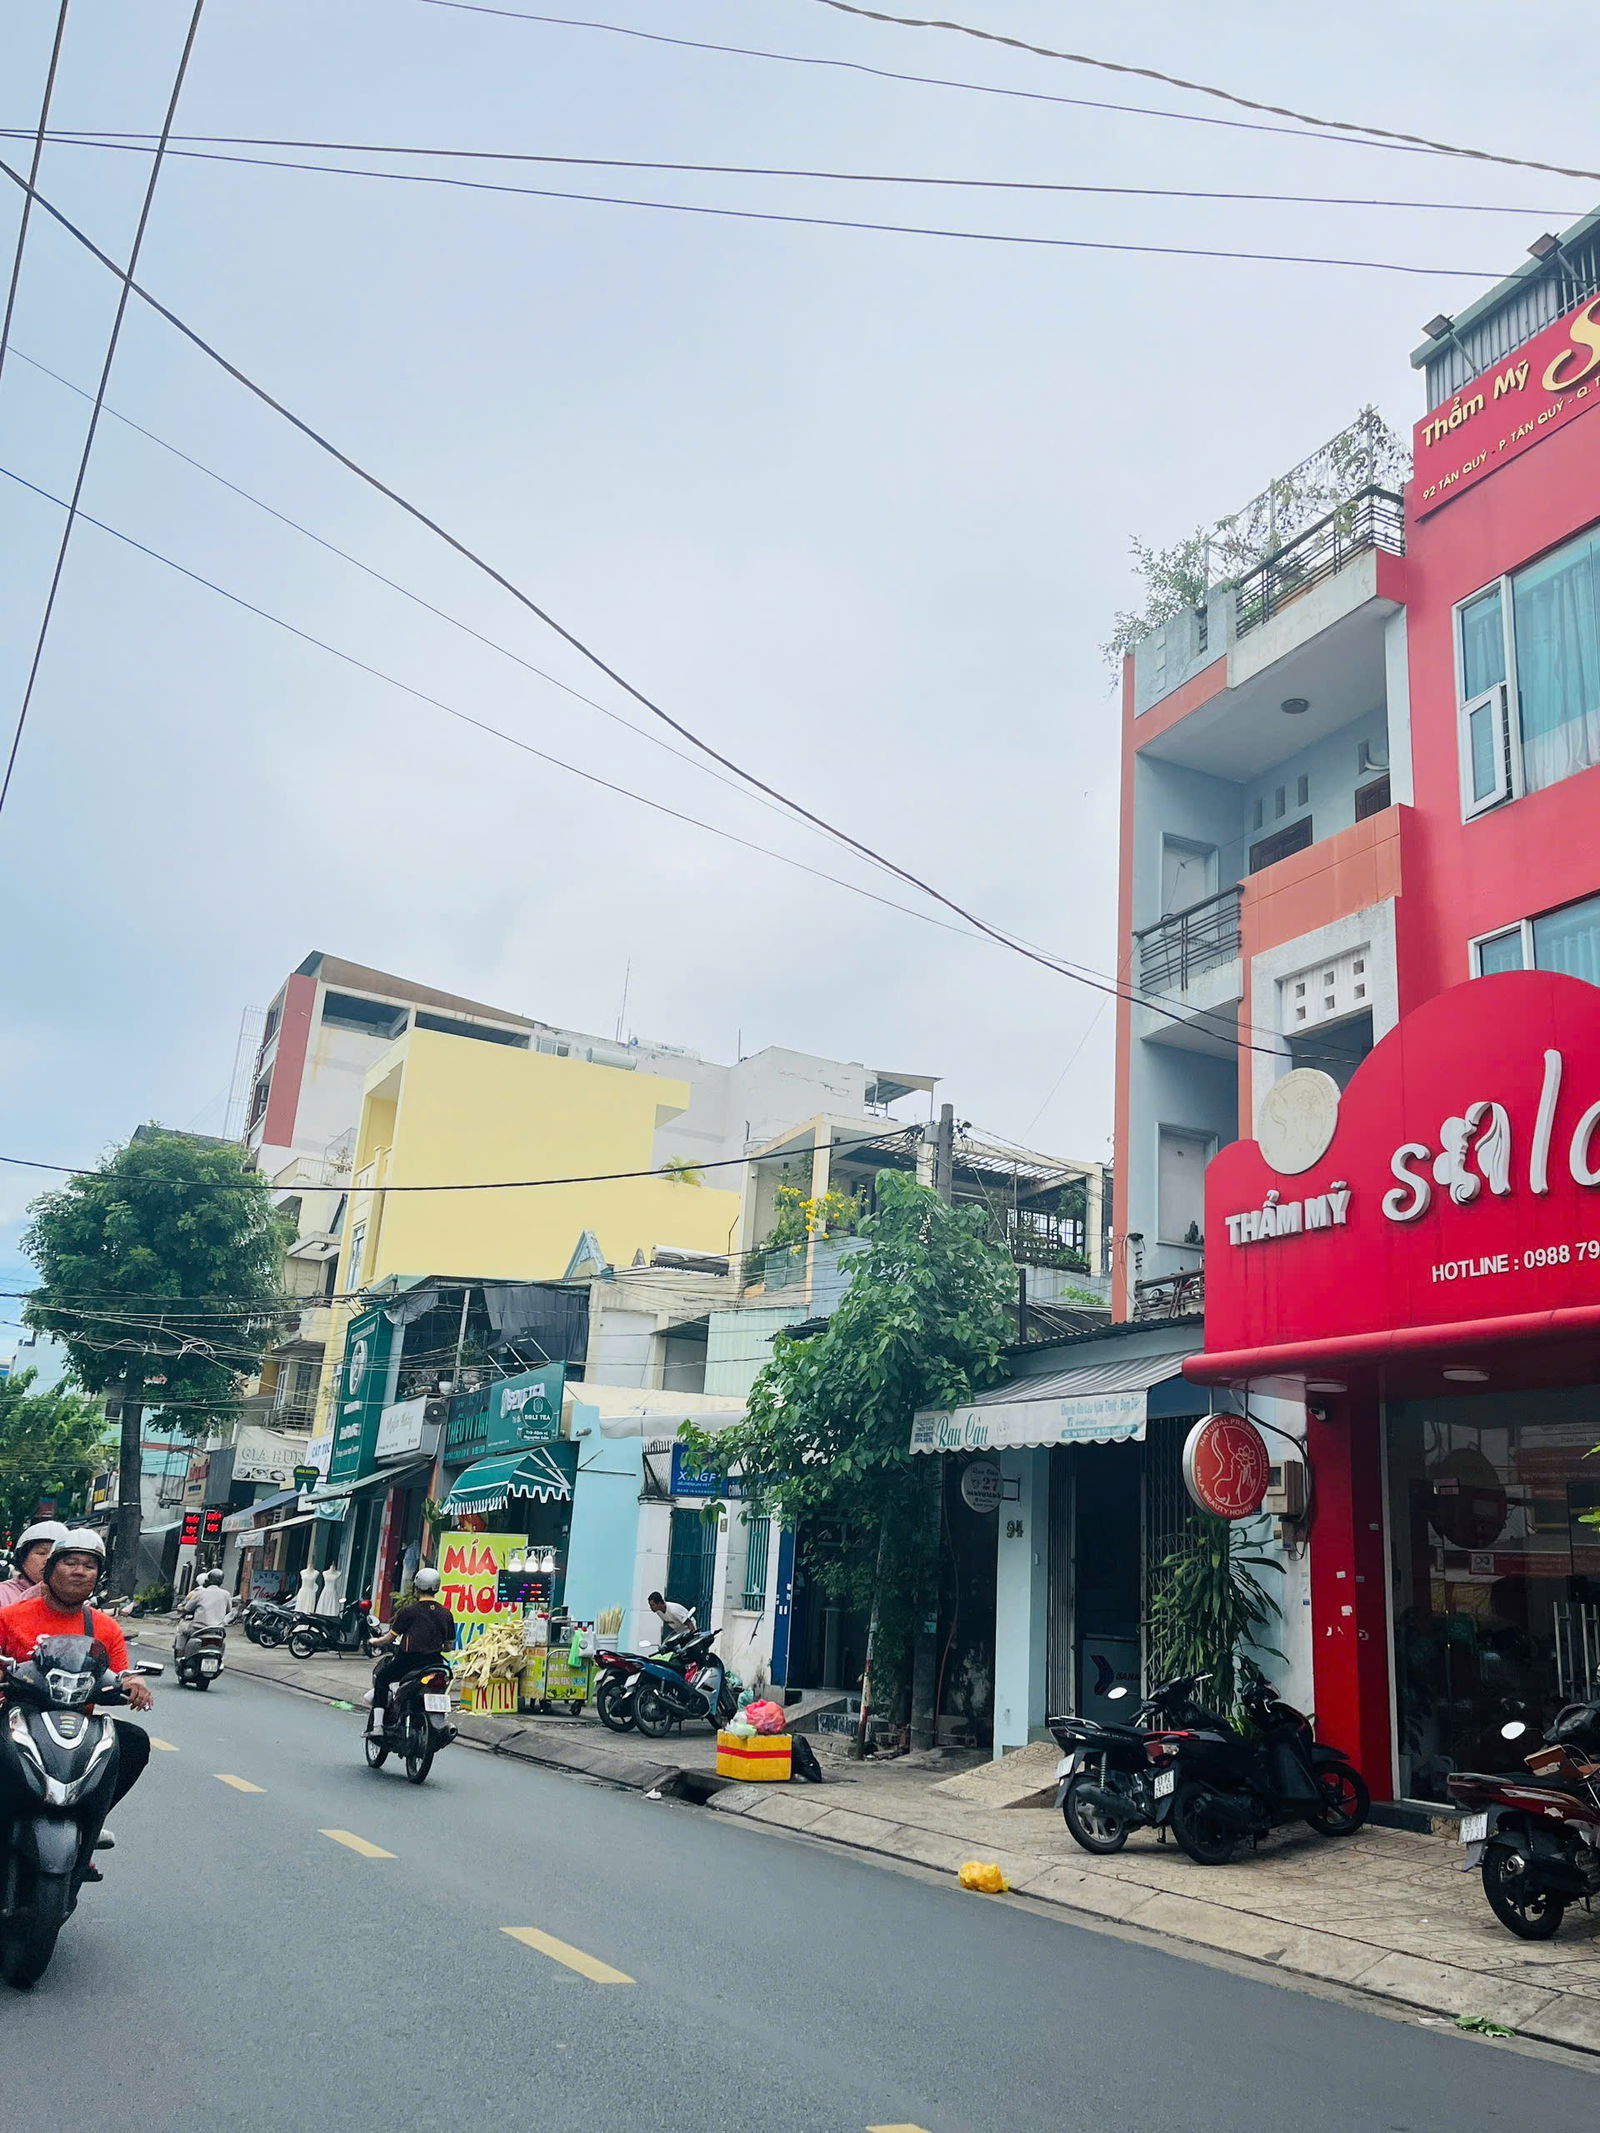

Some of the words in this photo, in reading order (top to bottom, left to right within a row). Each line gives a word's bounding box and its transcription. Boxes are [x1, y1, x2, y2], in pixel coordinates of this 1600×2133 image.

[1421, 396, 1485, 447] Thẩm
[1493, 359, 1530, 400] Mỹ
[1422, 485, 1437, 501] 92
[1438, 470, 1460, 491] TÂN
[1511, 419, 1535, 443] TÂN
[1225, 1189, 1303, 1246] THẨM
[1304, 1180, 1352, 1231] MỸ
[1431, 1253, 1510, 1283] HOTLINE
[1523, 1244, 1571, 1269] 0988
[936, 1415, 962, 1448] Rau
[1199, 1419, 1229, 1448] NATURAL
[1202, 1489, 1229, 1515] BEAUTY
[1006, 1520, 1024, 1538] 94
[443, 1539, 498, 1576] MÍA
